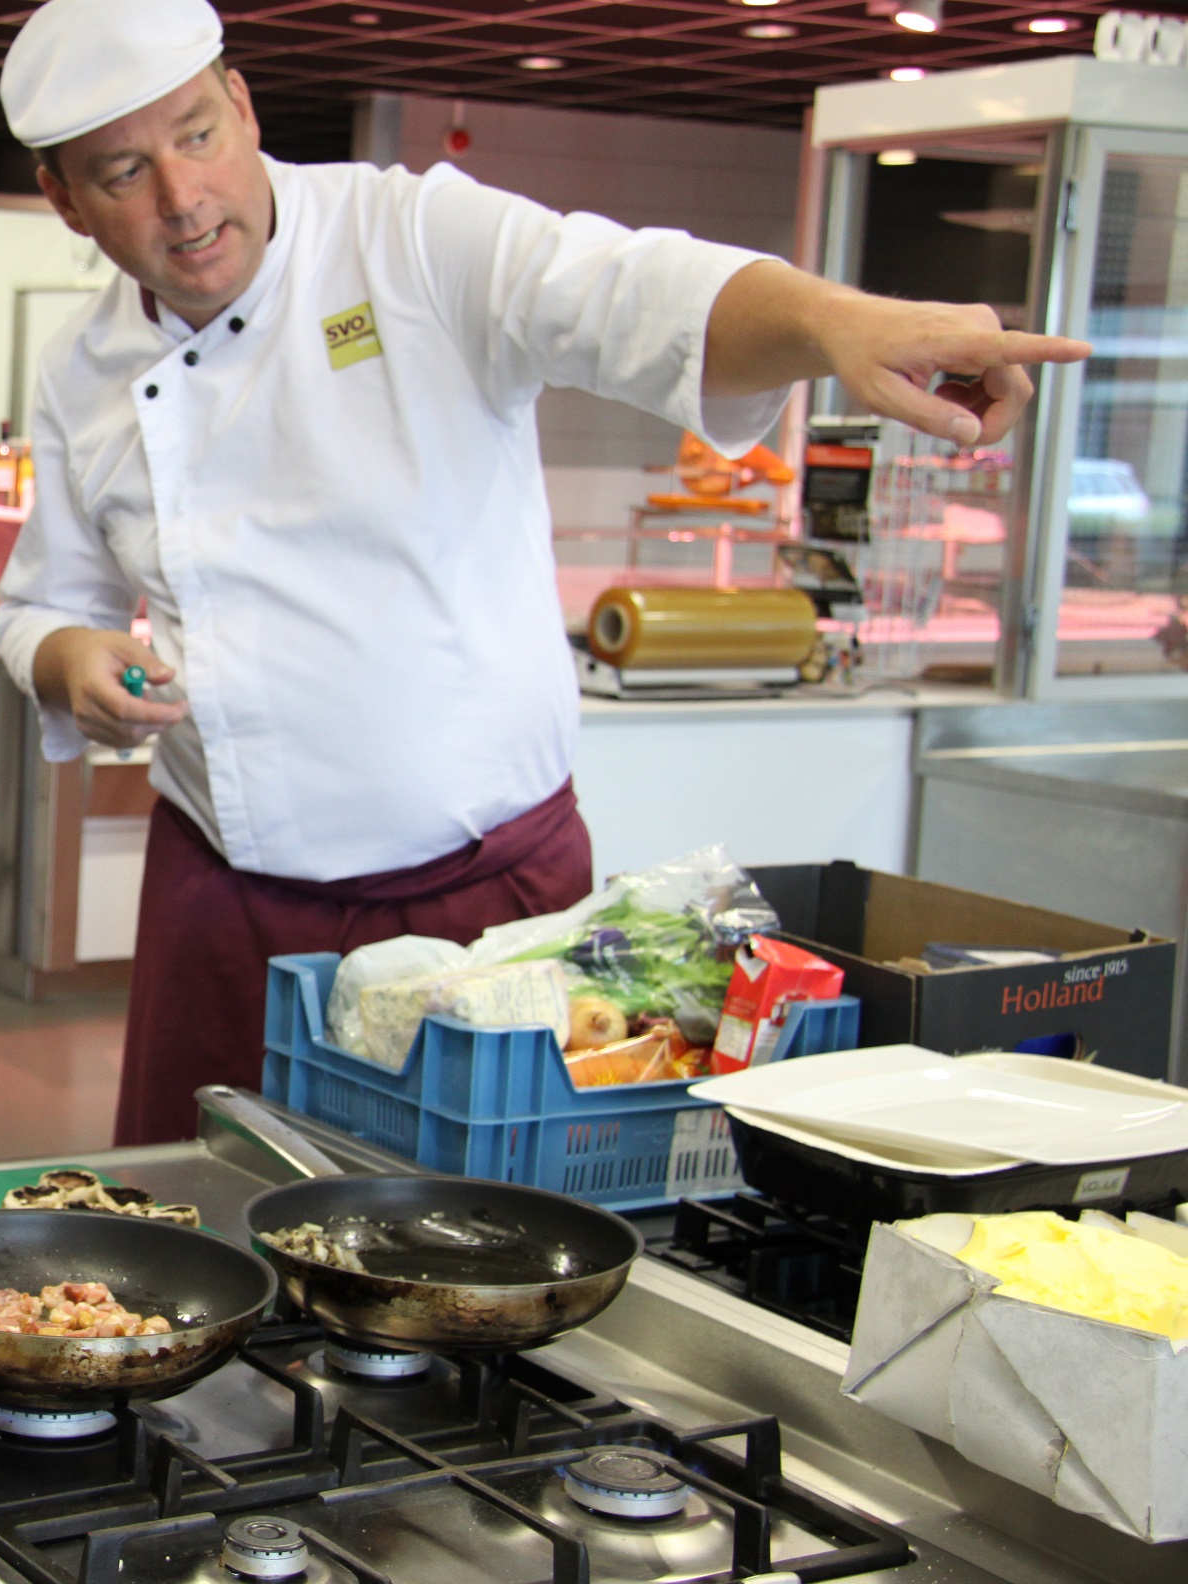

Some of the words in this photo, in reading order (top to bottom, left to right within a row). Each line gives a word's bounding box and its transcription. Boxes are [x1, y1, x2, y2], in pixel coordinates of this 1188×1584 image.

[1064, 964, 1101, 984] since
[1103, 958, 1129, 977] 1915
[1001, 973, 1105, 1015] Holland
